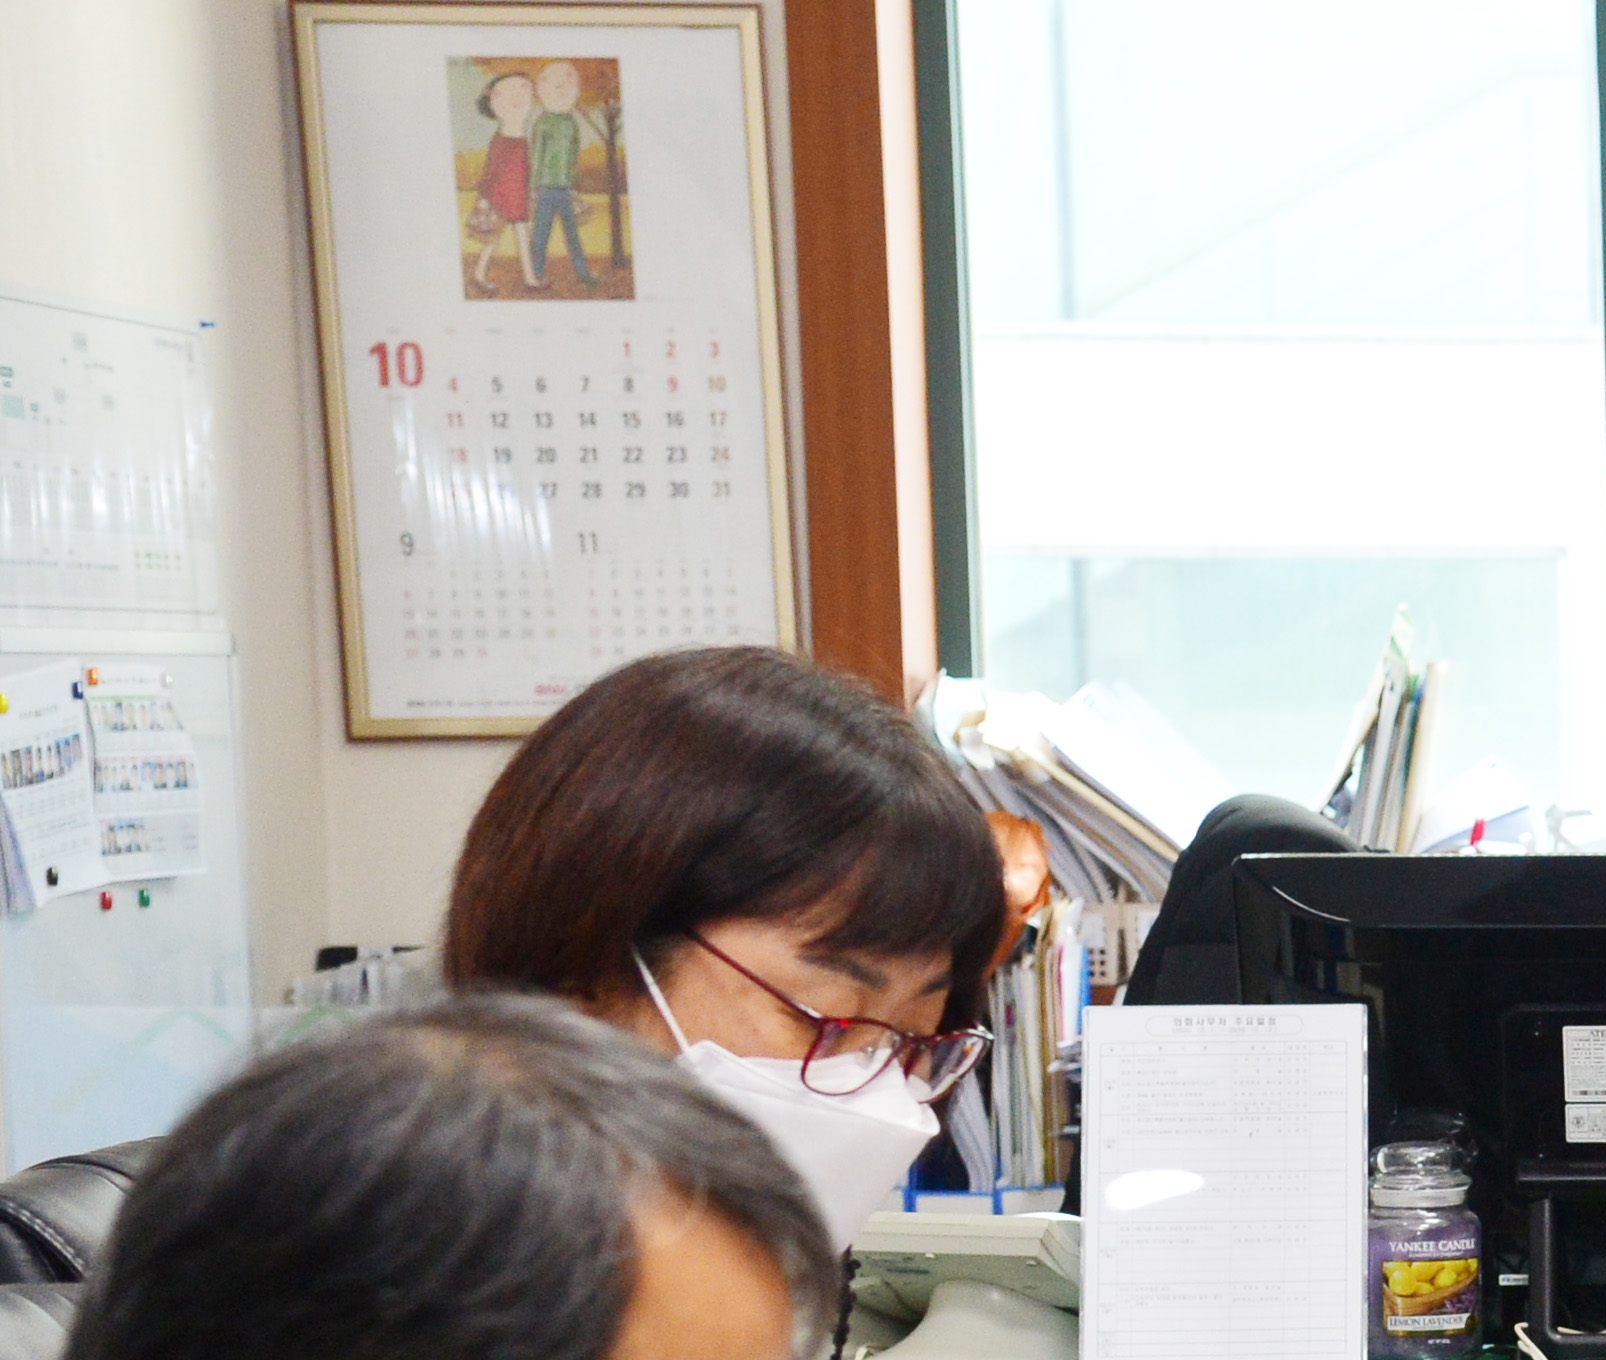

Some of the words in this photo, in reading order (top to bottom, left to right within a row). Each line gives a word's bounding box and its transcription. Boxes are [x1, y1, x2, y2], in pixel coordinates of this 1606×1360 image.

[622, 340, 632, 358] 1
[664, 339, 678, 360] 2
[709, 339, 721, 360] 3
[368, 341, 425, 389] 10
[490, 375, 504, 395] 5
[534, 376, 548, 395] 6
[581, 375, 592, 393] 7
[623, 375, 635, 394] 8
[447, 412, 464, 428] 11
[490, 412, 509, 429] 12
[534, 411, 554, 429] 13
[579, 412, 597, 427] 14
[622, 411, 641, 429] 15
[666, 412, 684, 427] 16
[709, 410, 727, 426] 17
[493, 447, 512, 464] 19
[537, 447, 556, 464] 20
[580, 447, 598, 464] 21
[623, 447, 643, 464] 22
[667, 446, 687, 463] 23
[582, 482, 602, 498] 28
[626, 482, 646, 498] 29
[669, 481, 689, 498] 30
[398, 532, 415, 558] 9
[576, 530, 600, 555] 11
[1388, 1240, 1436, 1253] YANKEE
[1389, 1317, 1421, 1327] LEMON
